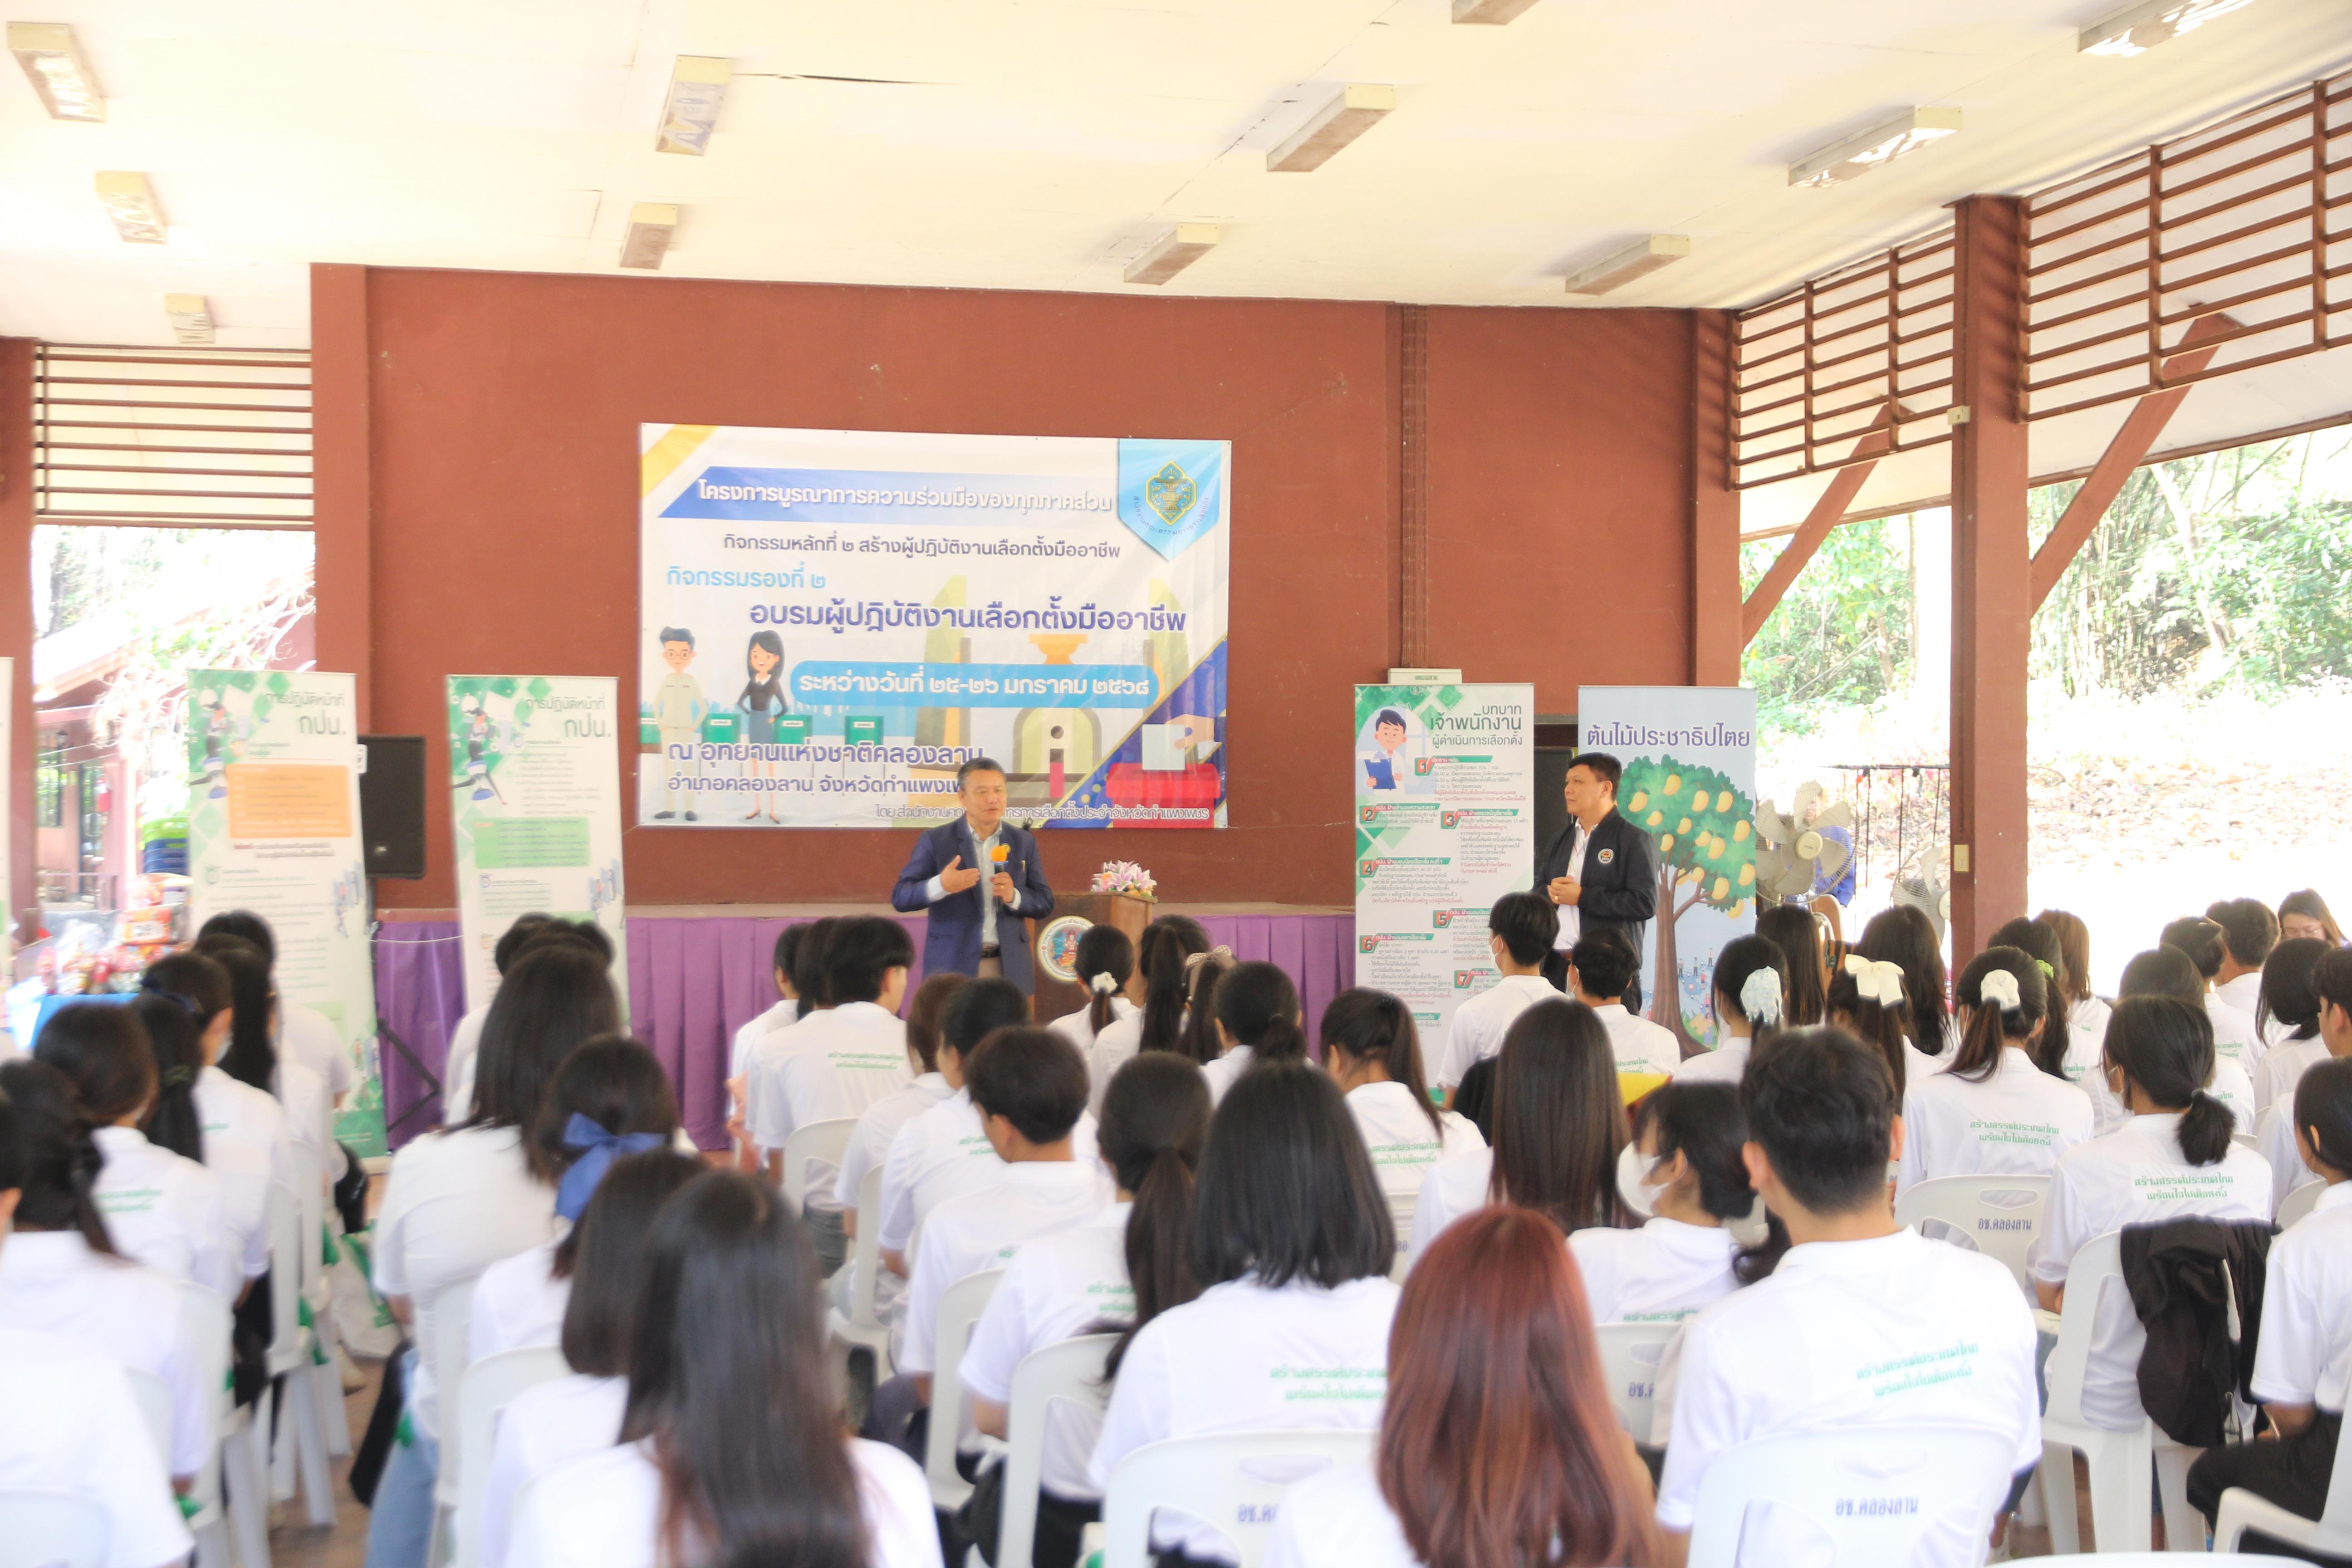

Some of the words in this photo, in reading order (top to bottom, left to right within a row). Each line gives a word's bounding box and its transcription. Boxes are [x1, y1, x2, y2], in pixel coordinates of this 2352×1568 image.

[698, 479, 1112, 514] โครงการบูรณาการความร่วมมือของทุกภาคส่วน
[724, 530, 838, 552] กิจกรรมหลักที่
[842, 539, 853, 552] ๒
[859, 534, 1121, 558] สร้างผู้ปฏิบัติงานเลือกตั้งมืออาชีพ
[666, 561, 804, 588] กิจกรรมรองที่
[811, 574, 826, 589] ๒
[750, 596, 1186, 634] อบรมผู้ปฏิบัติงานเลือกตั้งมืออาชีพ
[799, 664, 923, 693] ระหว่างวันที่
[929, 676, 999, 694] ๒๕-๒๖
[1004, 678, 1087, 695] มกราคม
[1092, 679, 1150, 696] ๒๕๖๘
[1482, 705, 1522, 715] บทบาท
[564, 713, 612, 738] กปน.
[1430, 712, 1522, 730] เจ้าพนักงาน
[1432, 731, 1523, 749] ผู้ดำเนินการเลือกตั้ง
[1587, 721, 1751, 747] ต้นไม้ประชาธิปไตย
[668, 743, 691, 760] ณ
[701, 738, 983, 767] อุทยานแห่งชาติคลองลาน
[1421, 762, 1427, 774] 1
[668, 774, 813, 792] อำเภอคลองลาน
[876, 804, 895, 818] โดย
[1366, 810, 1373, 821] 2
[1446, 815, 1455, 827] 3
[1365, 863, 1373, 875] 4
[1439, 914, 1447, 926] 5
[1365, 939, 1373, 951] 6
[1460, 974, 1468, 986] 7
[1978, 1218, 2032, 1230] อช.คลองลาน
[1836, 1496, 1919, 1516] อช.คลองลาน
